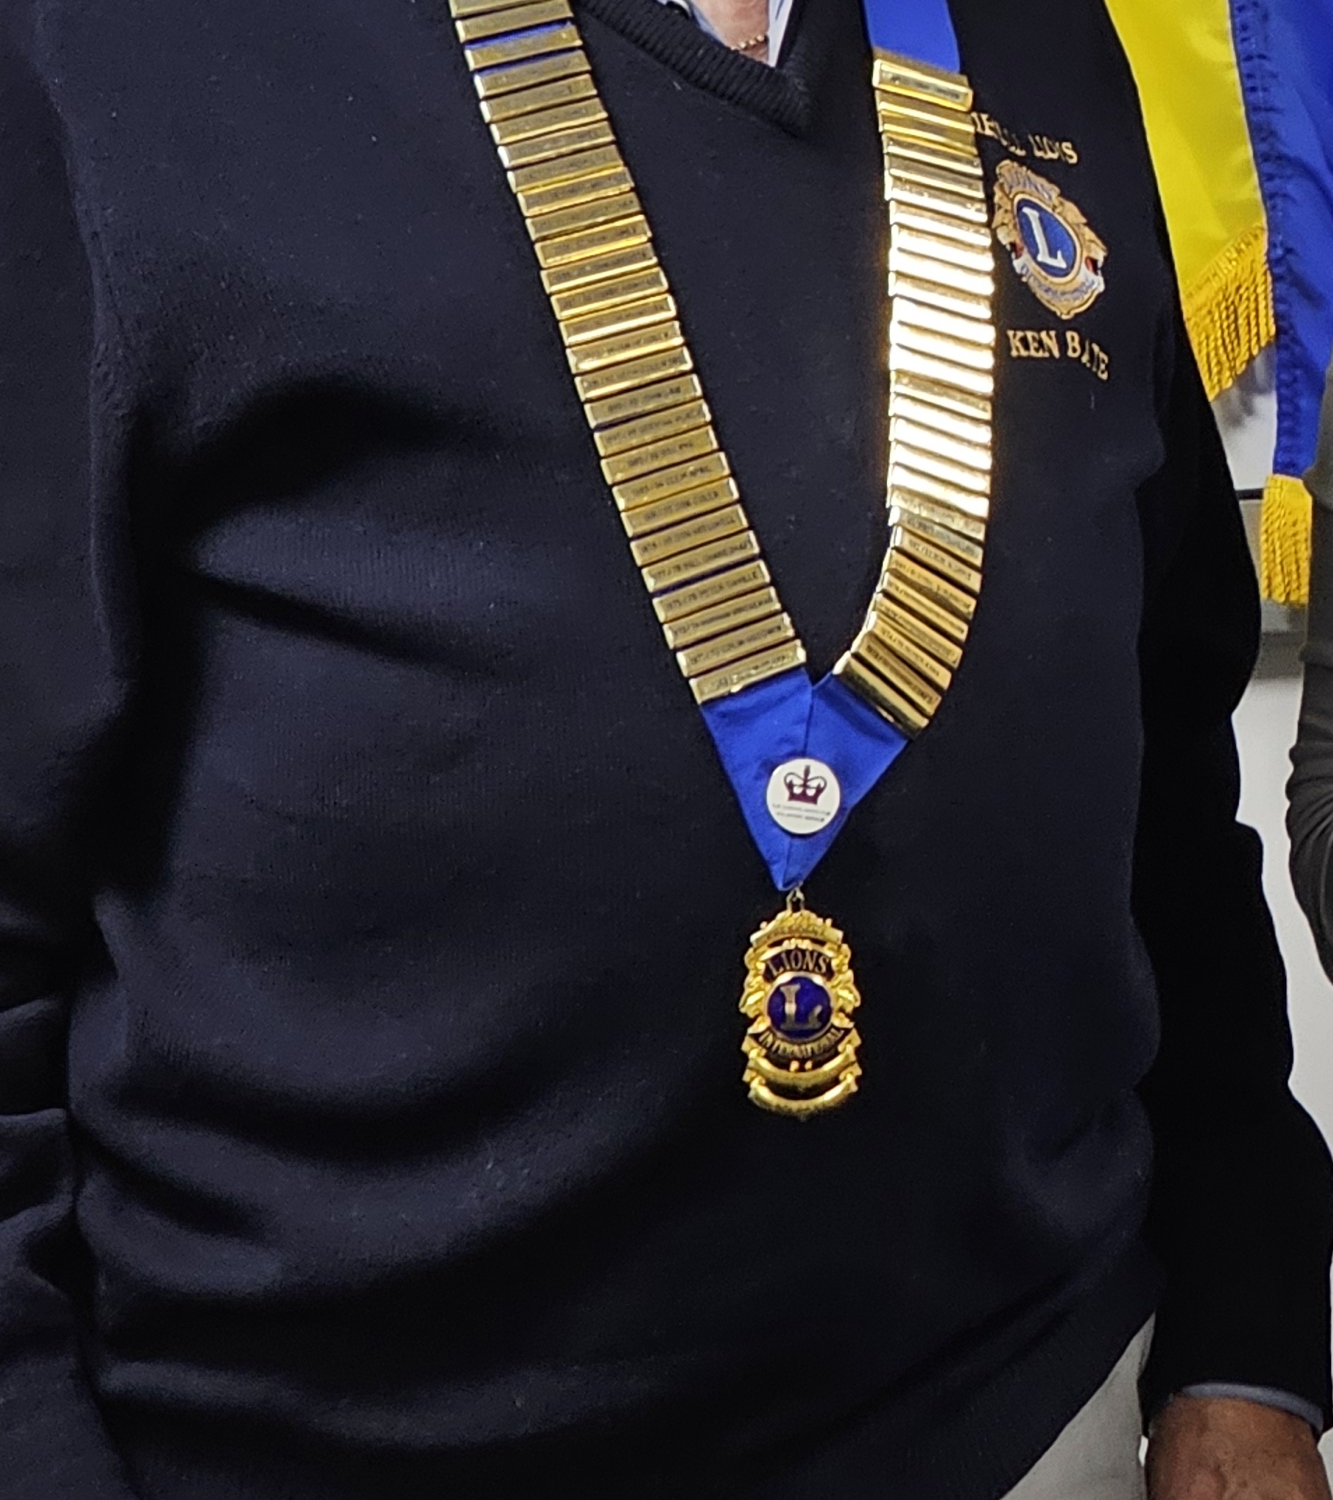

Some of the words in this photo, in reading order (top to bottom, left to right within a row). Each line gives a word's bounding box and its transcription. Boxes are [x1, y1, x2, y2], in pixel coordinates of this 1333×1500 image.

[1022, 206, 1067, 269] L
[1007, 330, 1060, 359] KEN
[767, 951, 829, 977] LIONS
[780, 984, 823, 1030] L
